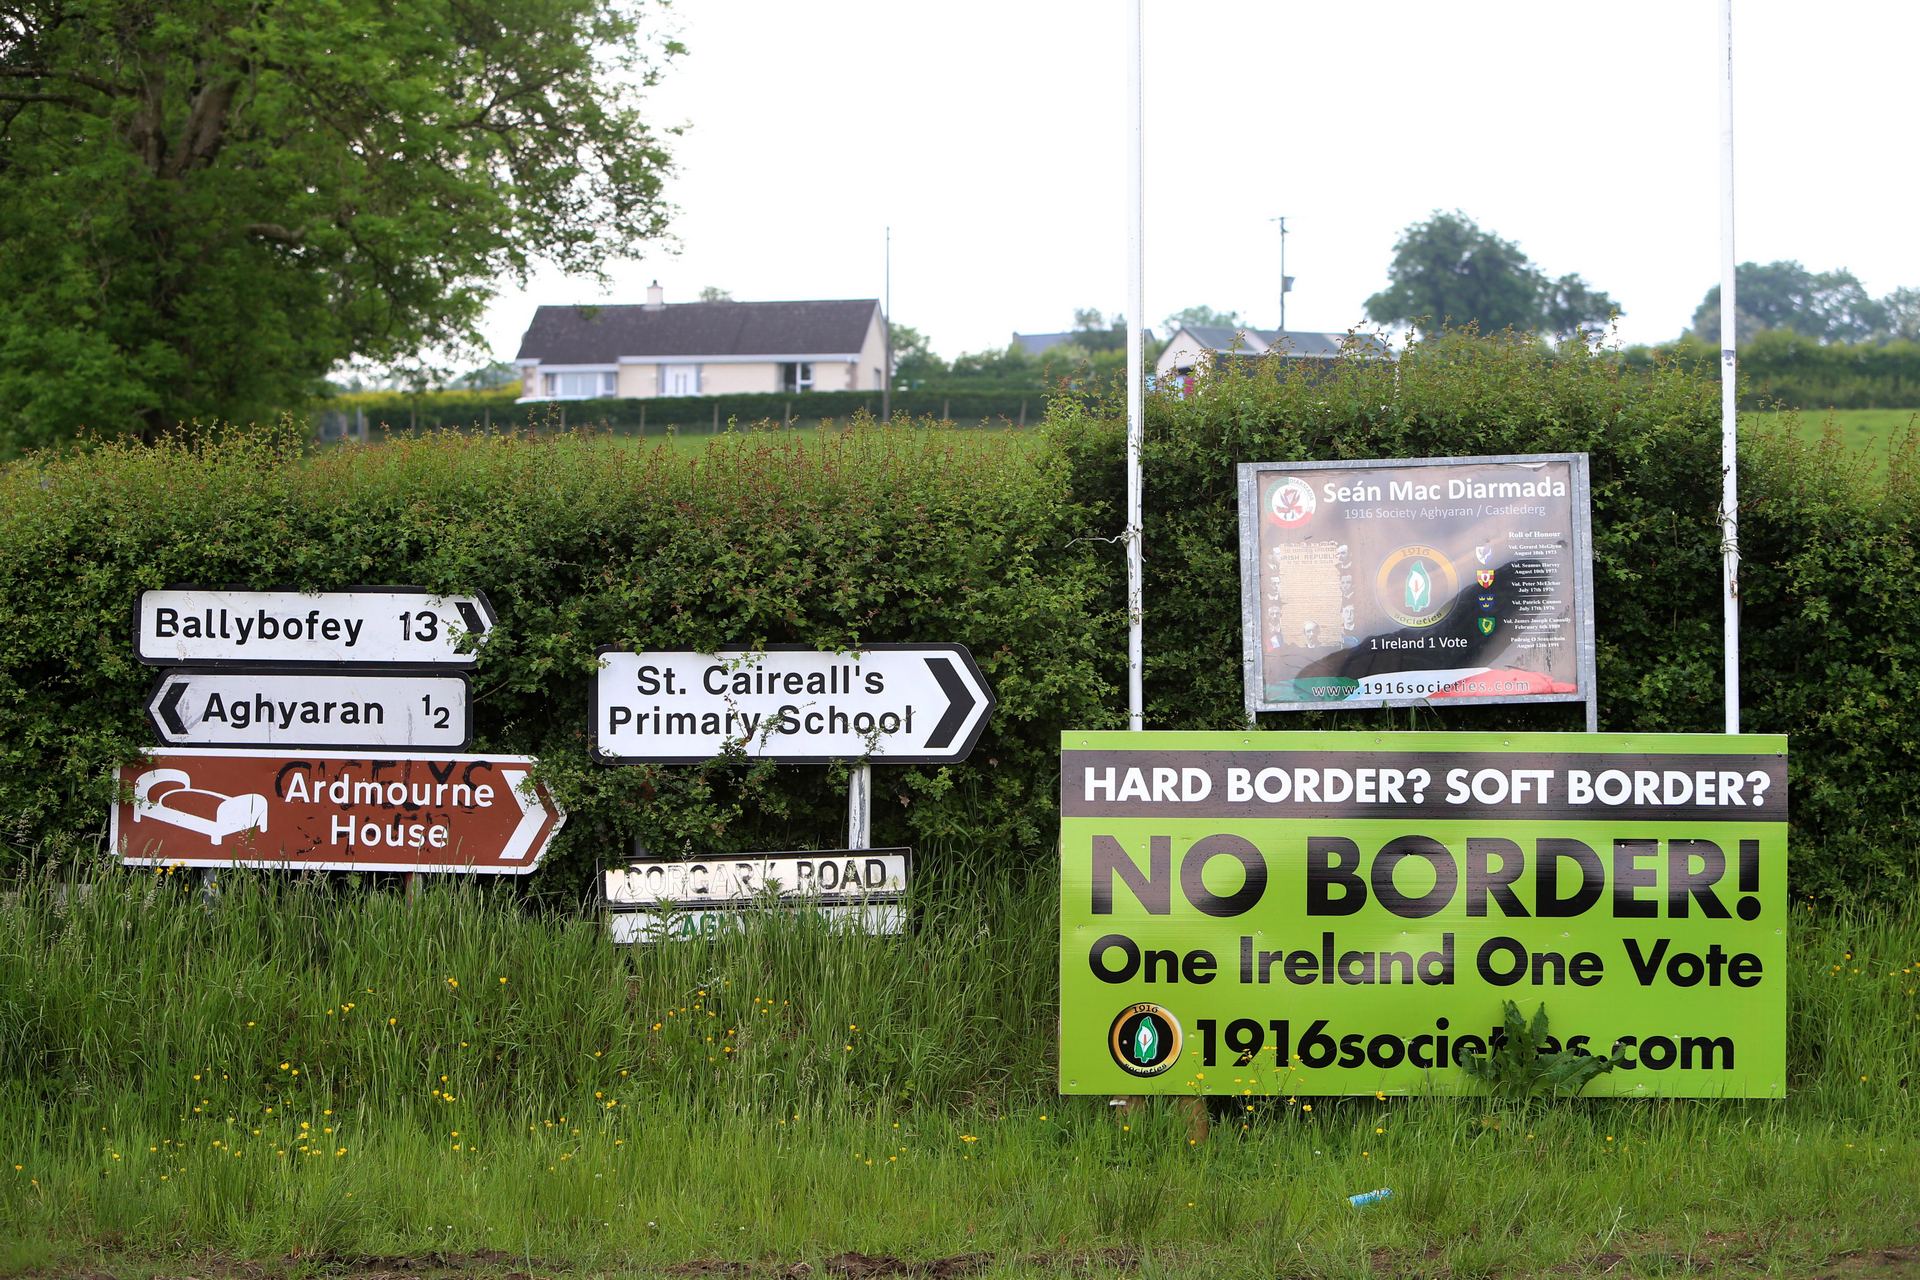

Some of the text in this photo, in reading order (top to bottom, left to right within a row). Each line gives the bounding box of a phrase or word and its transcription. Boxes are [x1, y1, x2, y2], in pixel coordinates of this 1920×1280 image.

[1323, 476, 1566, 503] Seán Mac Diarmada
[1344, 508, 1373, 519] 1916
[1376, 507, 1417, 521] Society
[1420, 507, 1474, 520] Aghyaran
[1485, 503, 1546, 518] Castlederg
[1400, 547, 1430, 557] 1916
[155, 607, 439, 647] Ballybofey 13
[1370, 637, 1468, 650] 1 Ireland 1 Vote
[636, 664, 885, 695] St. Caireall's
[1311, 678, 1530, 698] www.1916societies.com
[201, 692, 384, 730] Aghyaran
[609, 705, 913, 741] Primary School
[284, 772, 495, 808] Ardmourne
[1083, 767, 1771, 806] HARD BORDER? SOFT BORDER?
[331, 814, 449, 847] House
[796, 858, 887, 891] ROAD
[1091, 833, 1762, 921] NO BORDER!
[1088, 931, 1763, 988] One Ireland One Vote
[1133, 1004, 1160, 1014] 1916
[1196, 1016, 1735, 1070] 1916societes.com
